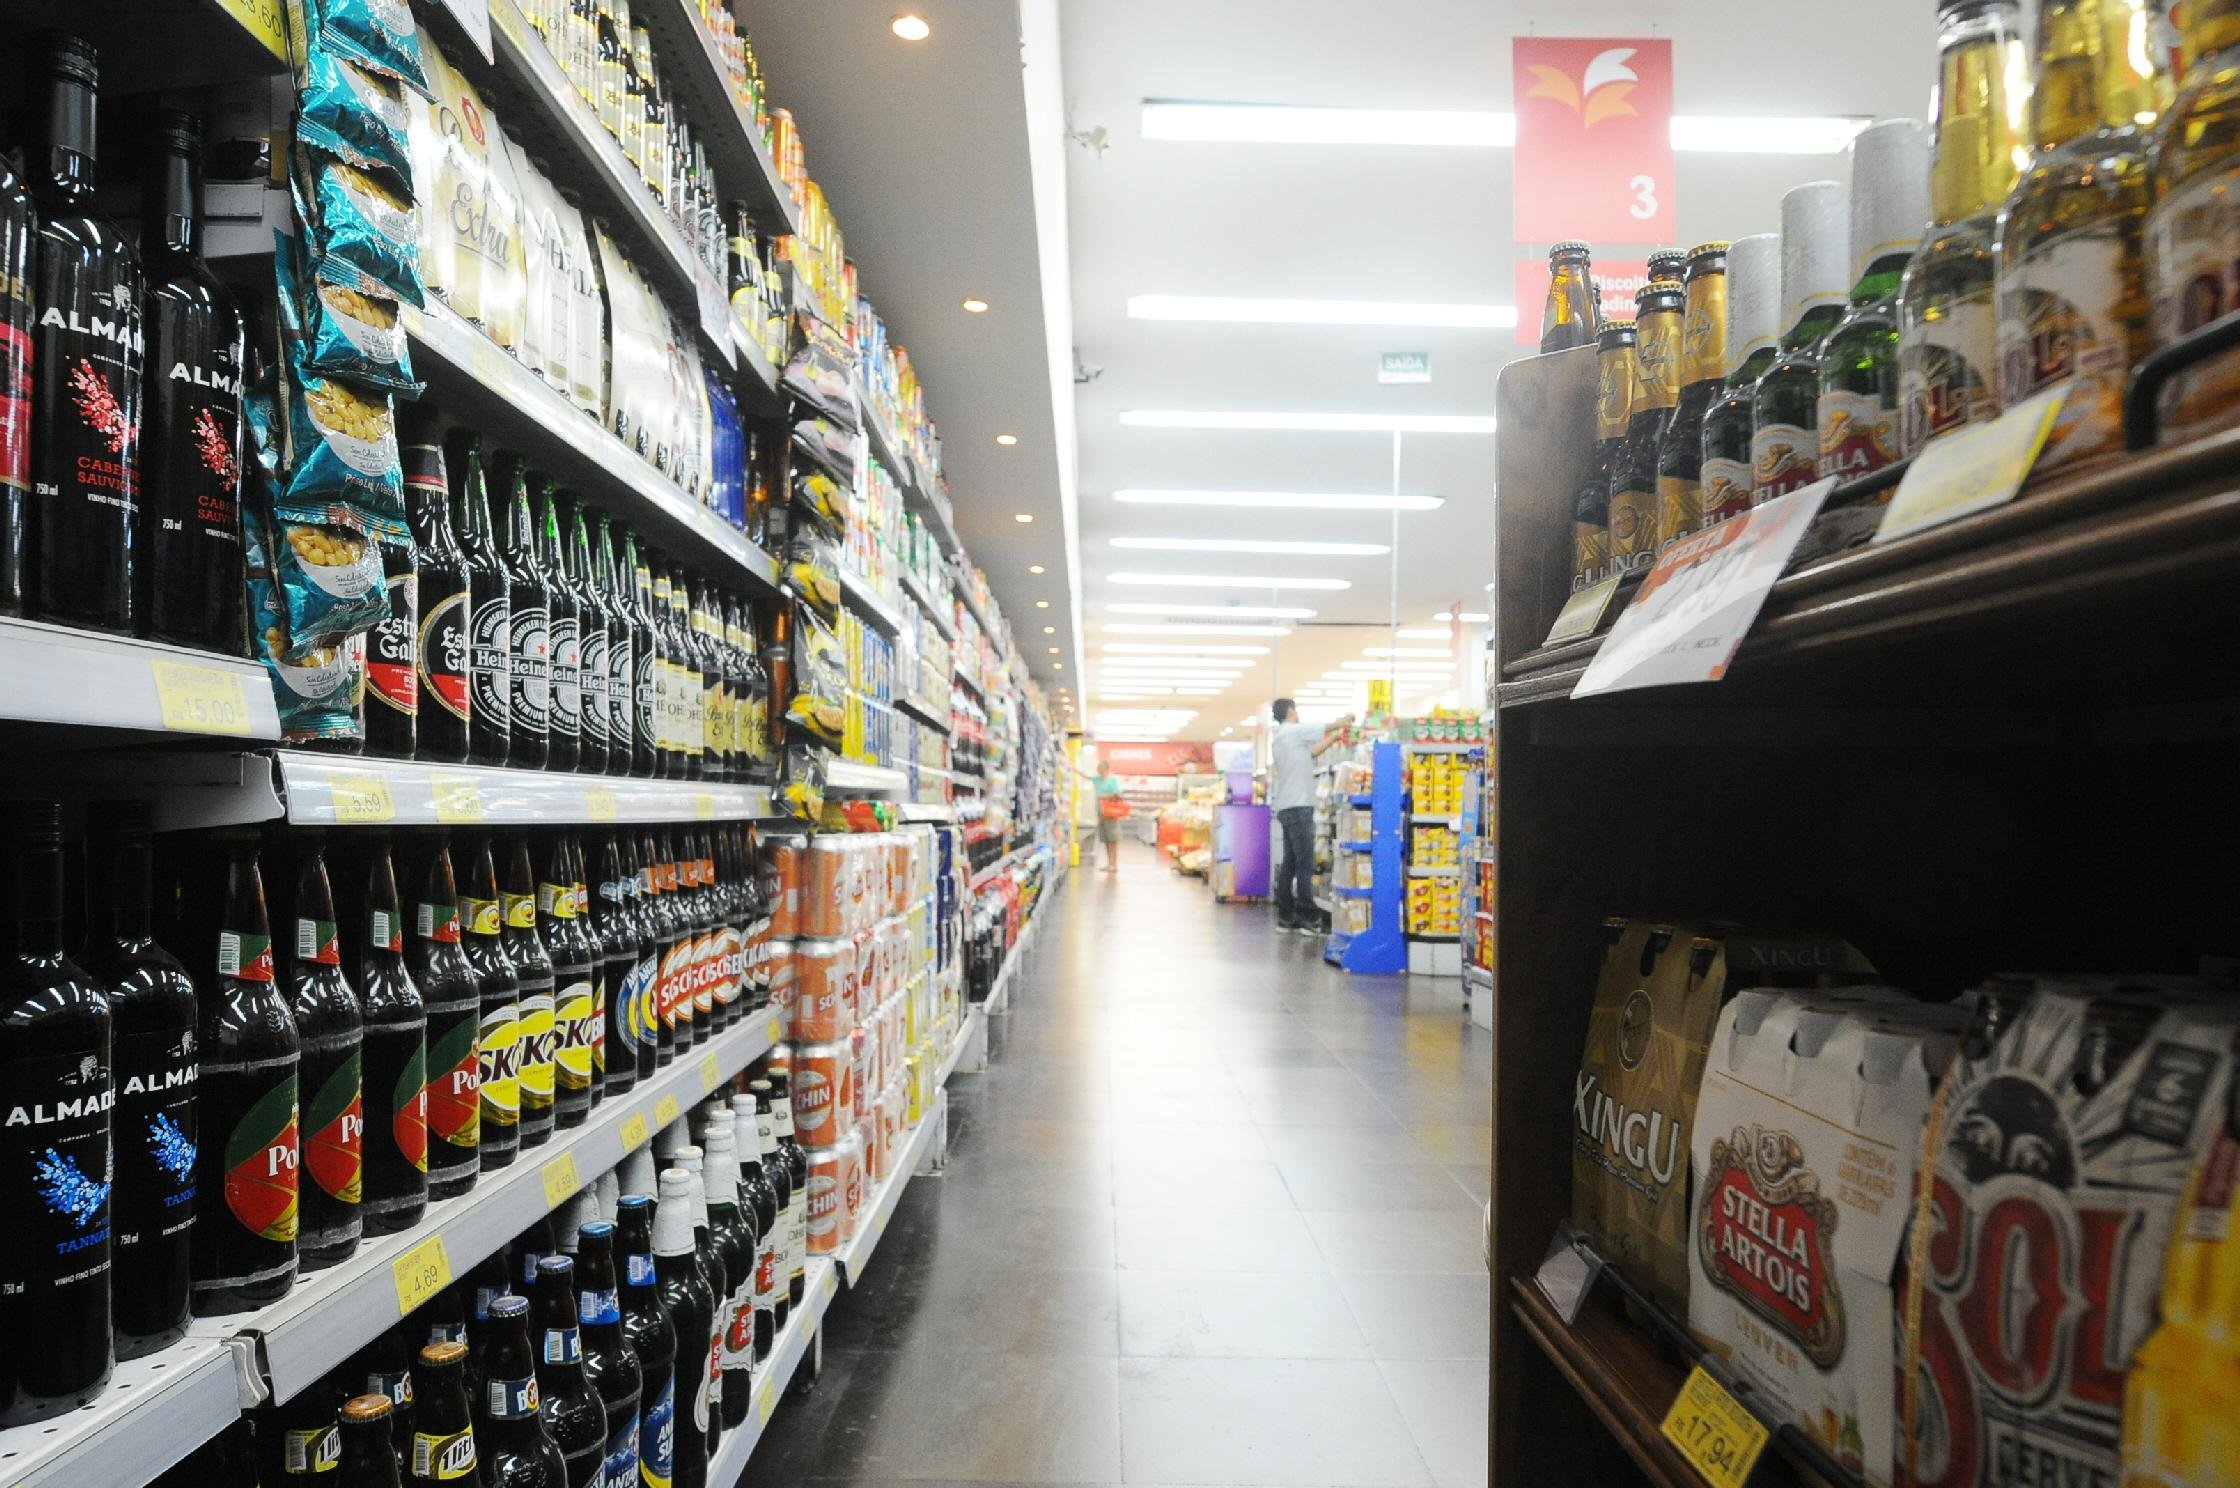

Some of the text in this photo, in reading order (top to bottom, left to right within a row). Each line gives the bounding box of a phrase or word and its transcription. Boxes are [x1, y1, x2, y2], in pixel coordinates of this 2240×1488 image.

[1629, 174, 1658, 219] 3
[1572, 1070, 1679, 1185] XINGU
[1723, 1185, 1810, 1269] STELLA
[414, 1265, 439, 1294] 4,69
[1721, 1223, 1811, 1313] ARTOIS
[1687, 1415, 1736, 1475] 17,94
